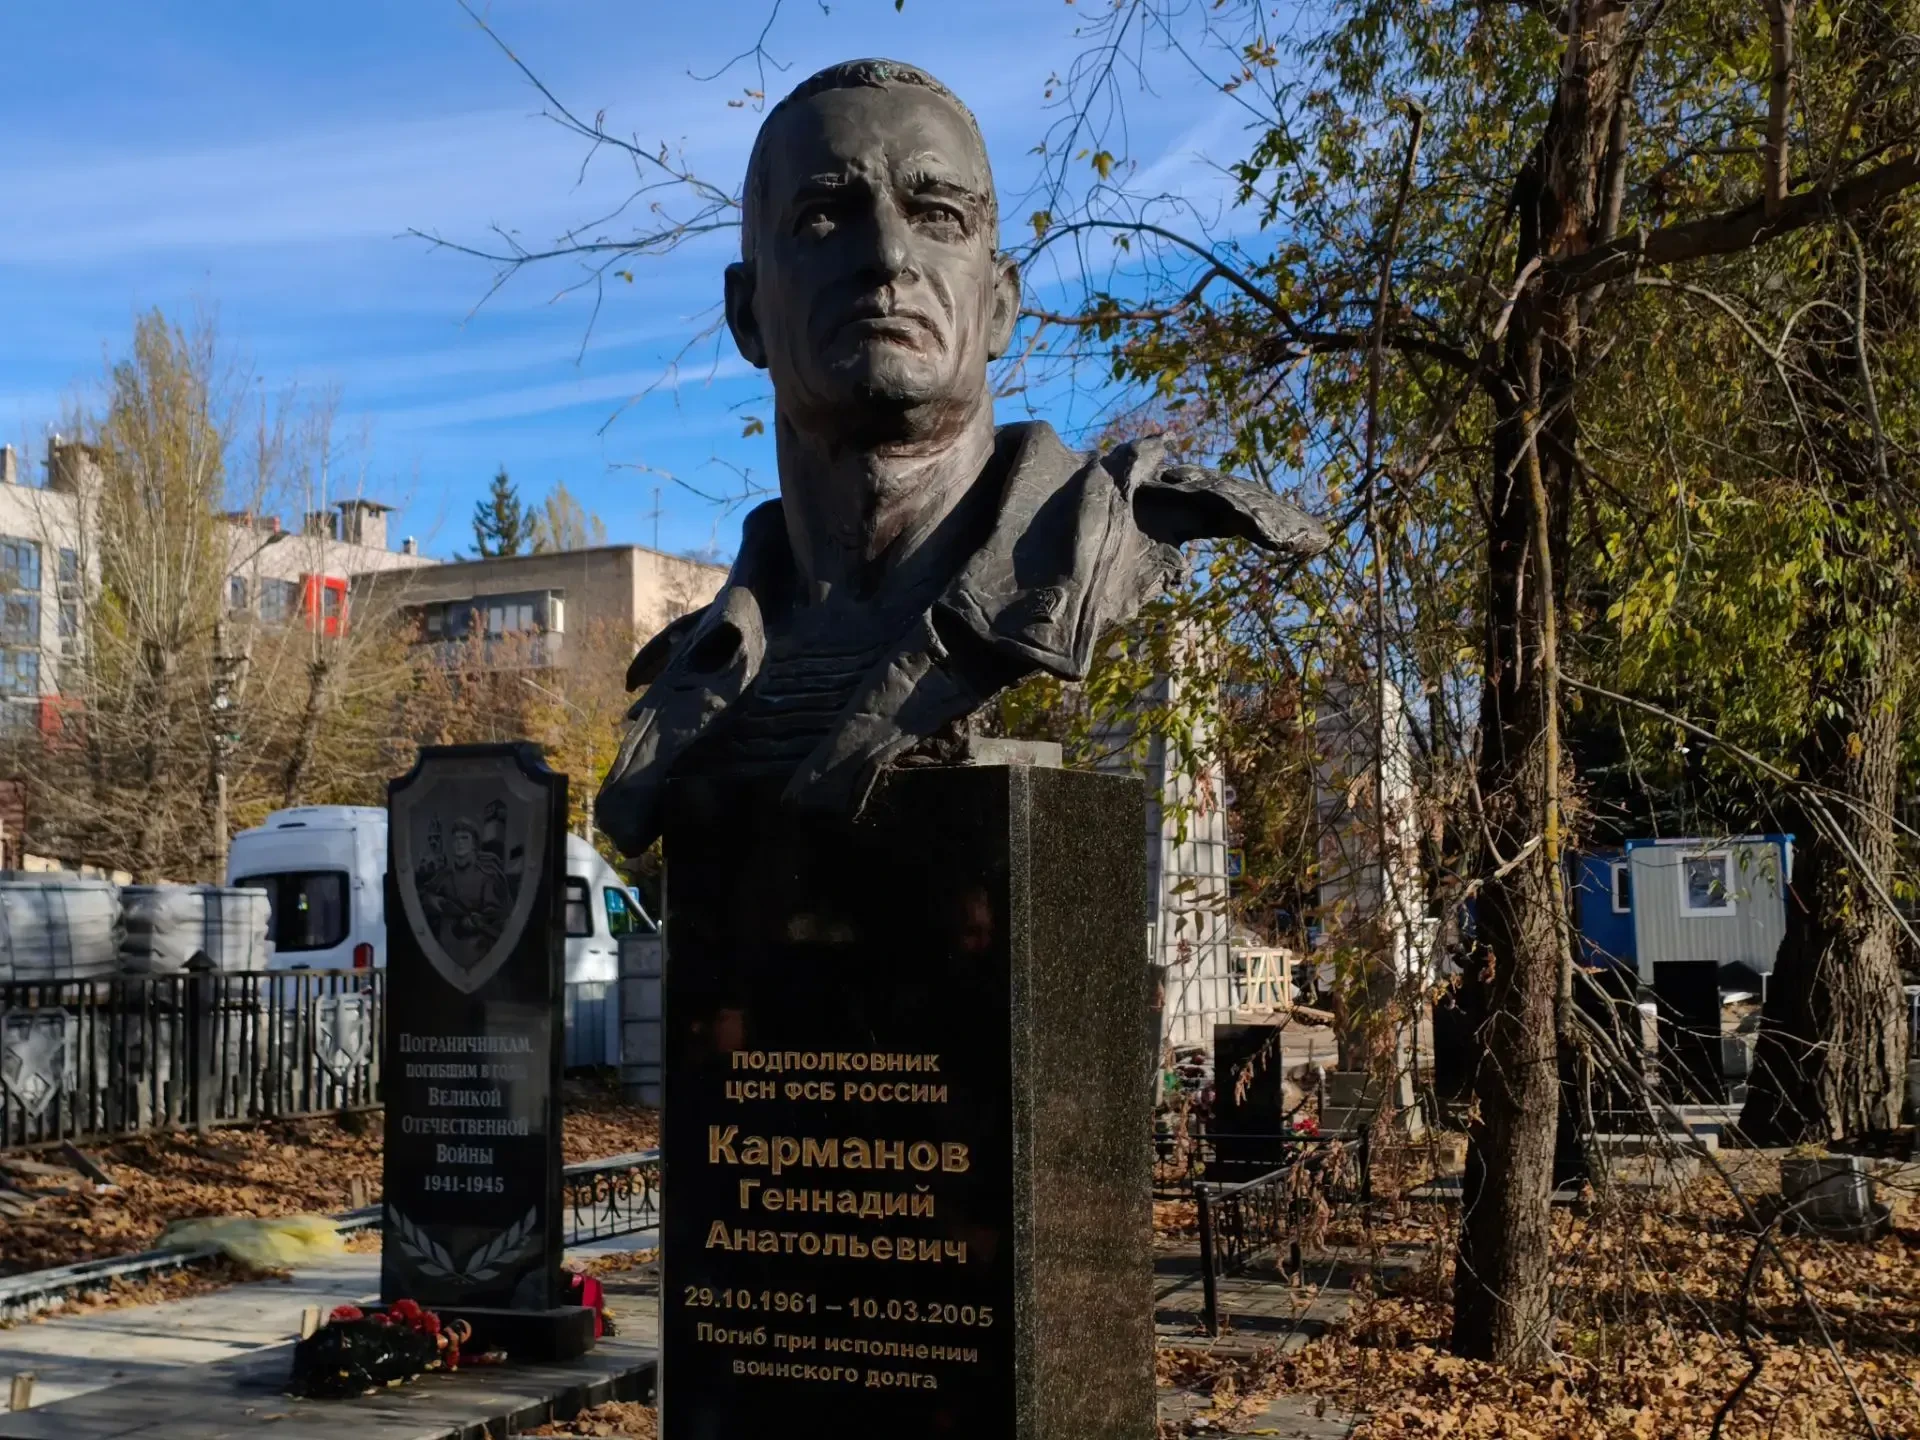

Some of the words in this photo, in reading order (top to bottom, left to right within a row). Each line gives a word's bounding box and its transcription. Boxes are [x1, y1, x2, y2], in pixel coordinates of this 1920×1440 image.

[492, 1064, 528, 1081] ГО
[731, 1050, 941, 1073] ПОДПОЛКОВНИК
[725, 1080, 776, 1103] ЦСН
[784, 1081, 836, 1101] ФСБ
[843, 1082, 948, 1103] РОССИИ
[708, 1124, 971, 1175] Карманов
[423, 1175, 505, 1193] 1941-1945
[739, 1178, 935, 1218] Геннадий
[705, 1219, 968, 1264] Анатольевич
[684, 1286, 817, 1313] 29.10.1961
[849, 1297, 994, 1327] 10.03.2005
[697, 1322, 767, 1345] Погиб
[773, 1332, 817, 1352] при
[824, 1337, 979, 1362] исполнении
[864, 1369, 938, 1389] долга
